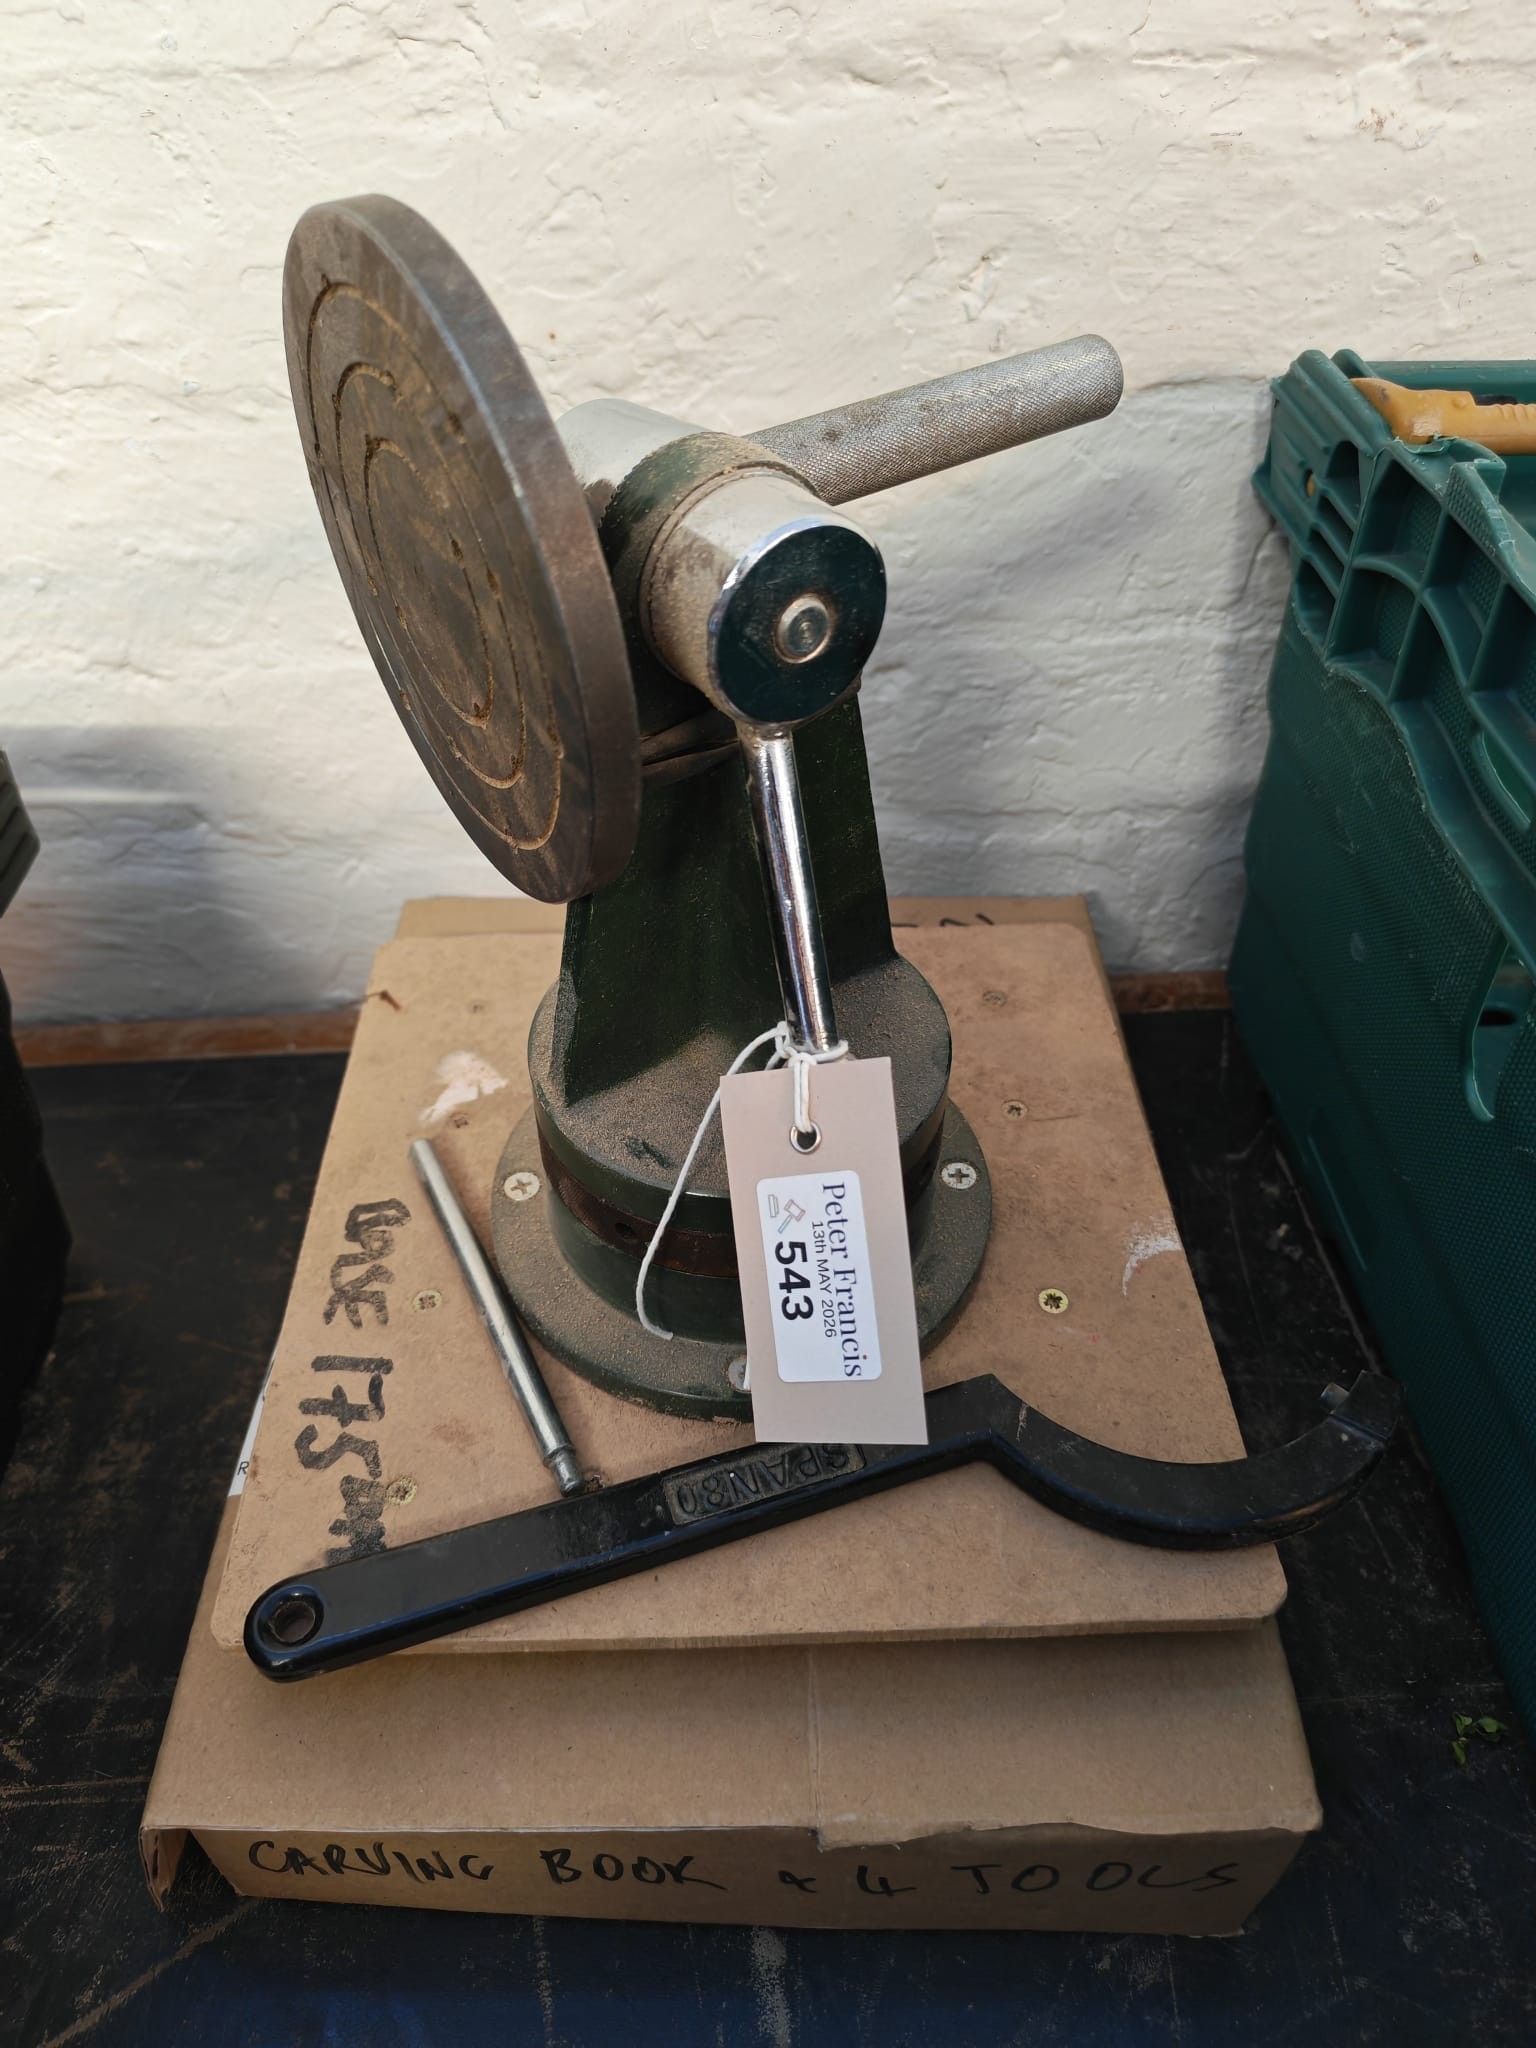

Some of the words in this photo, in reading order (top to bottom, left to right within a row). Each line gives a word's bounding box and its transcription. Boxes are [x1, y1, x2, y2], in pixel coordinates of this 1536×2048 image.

[811, 1221, 826, 1255] 13th
[822, 1181, 849, 1260] Peter
[775, 1241, 813, 1320] 543
[816, 1257, 833, 1293] MAY
[821, 1299, 838, 1339] 2026
[834, 1268, 867, 1377] Francis
[248, 1839, 495, 1884] CARVING
[539, 1847, 729, 1892] BOOK
[857, 1864, 917, 1897] 4
[951, 1861, 1240, 1896] TOOLS
